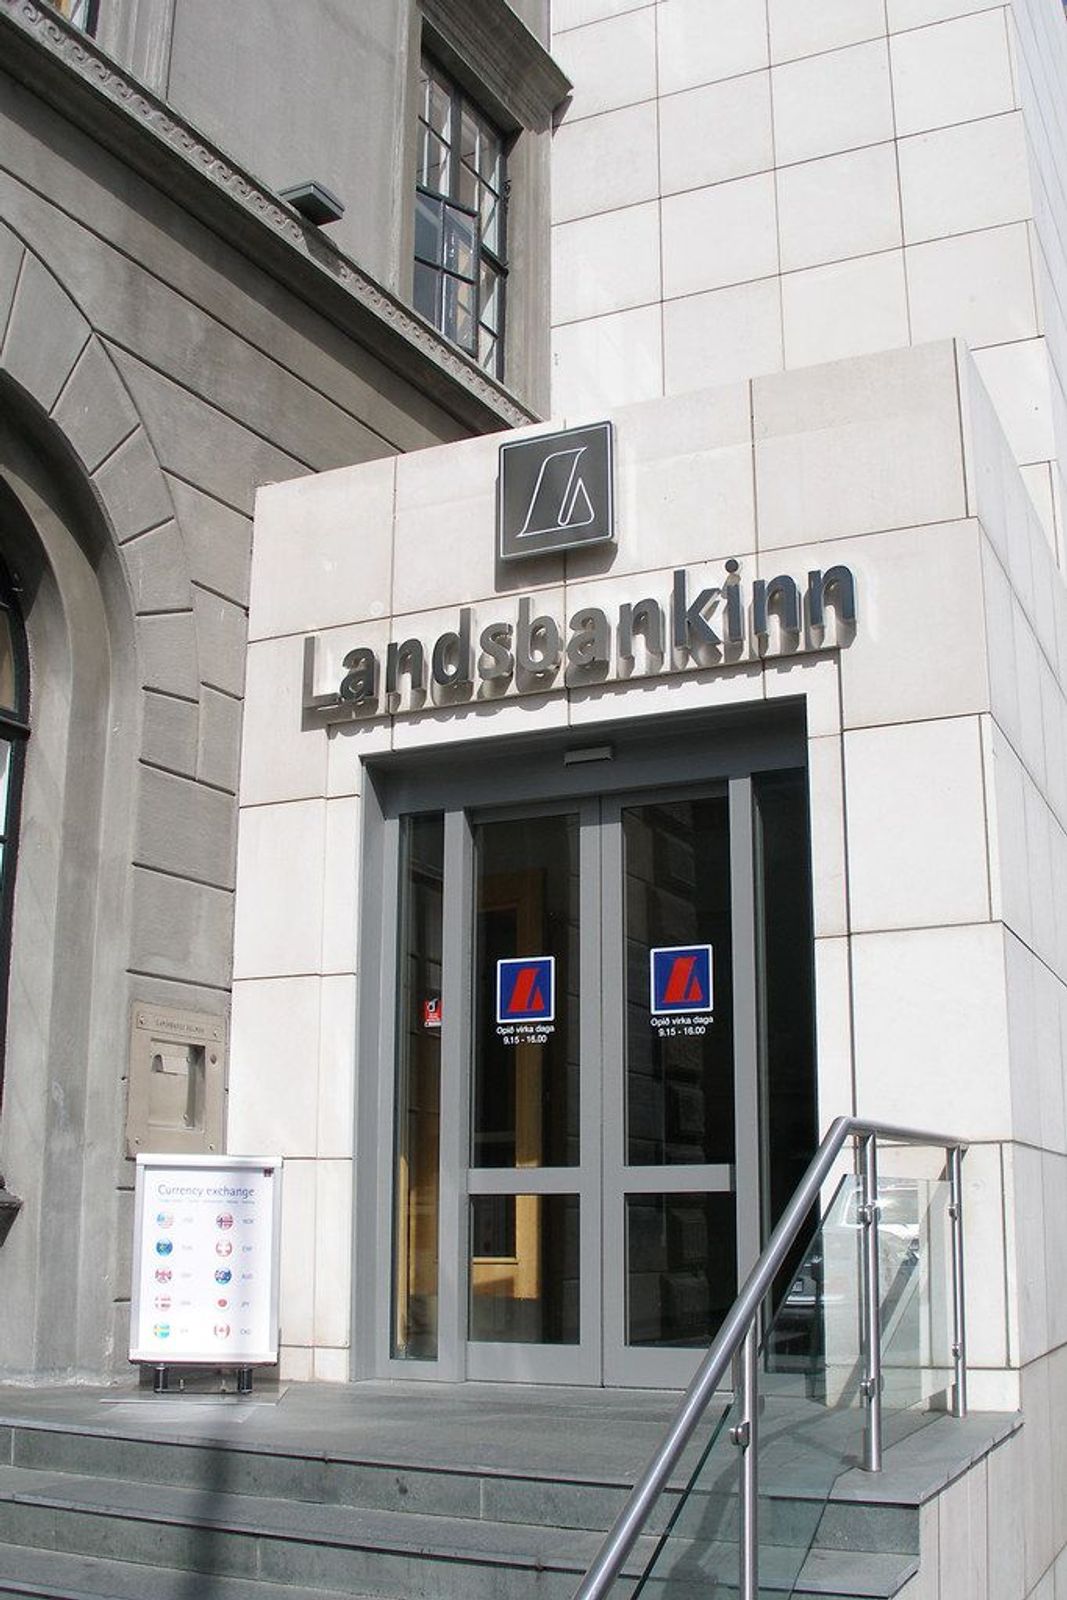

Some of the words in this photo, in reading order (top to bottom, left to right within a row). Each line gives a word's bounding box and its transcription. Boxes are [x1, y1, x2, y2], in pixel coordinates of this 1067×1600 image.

[302, 558, 857, 708] Landsbankinn
[693, 1016, 714, 1025] daga
[157, 1184, 203, 1196] Currency
[206, 1185, 255, 1199] exchange
